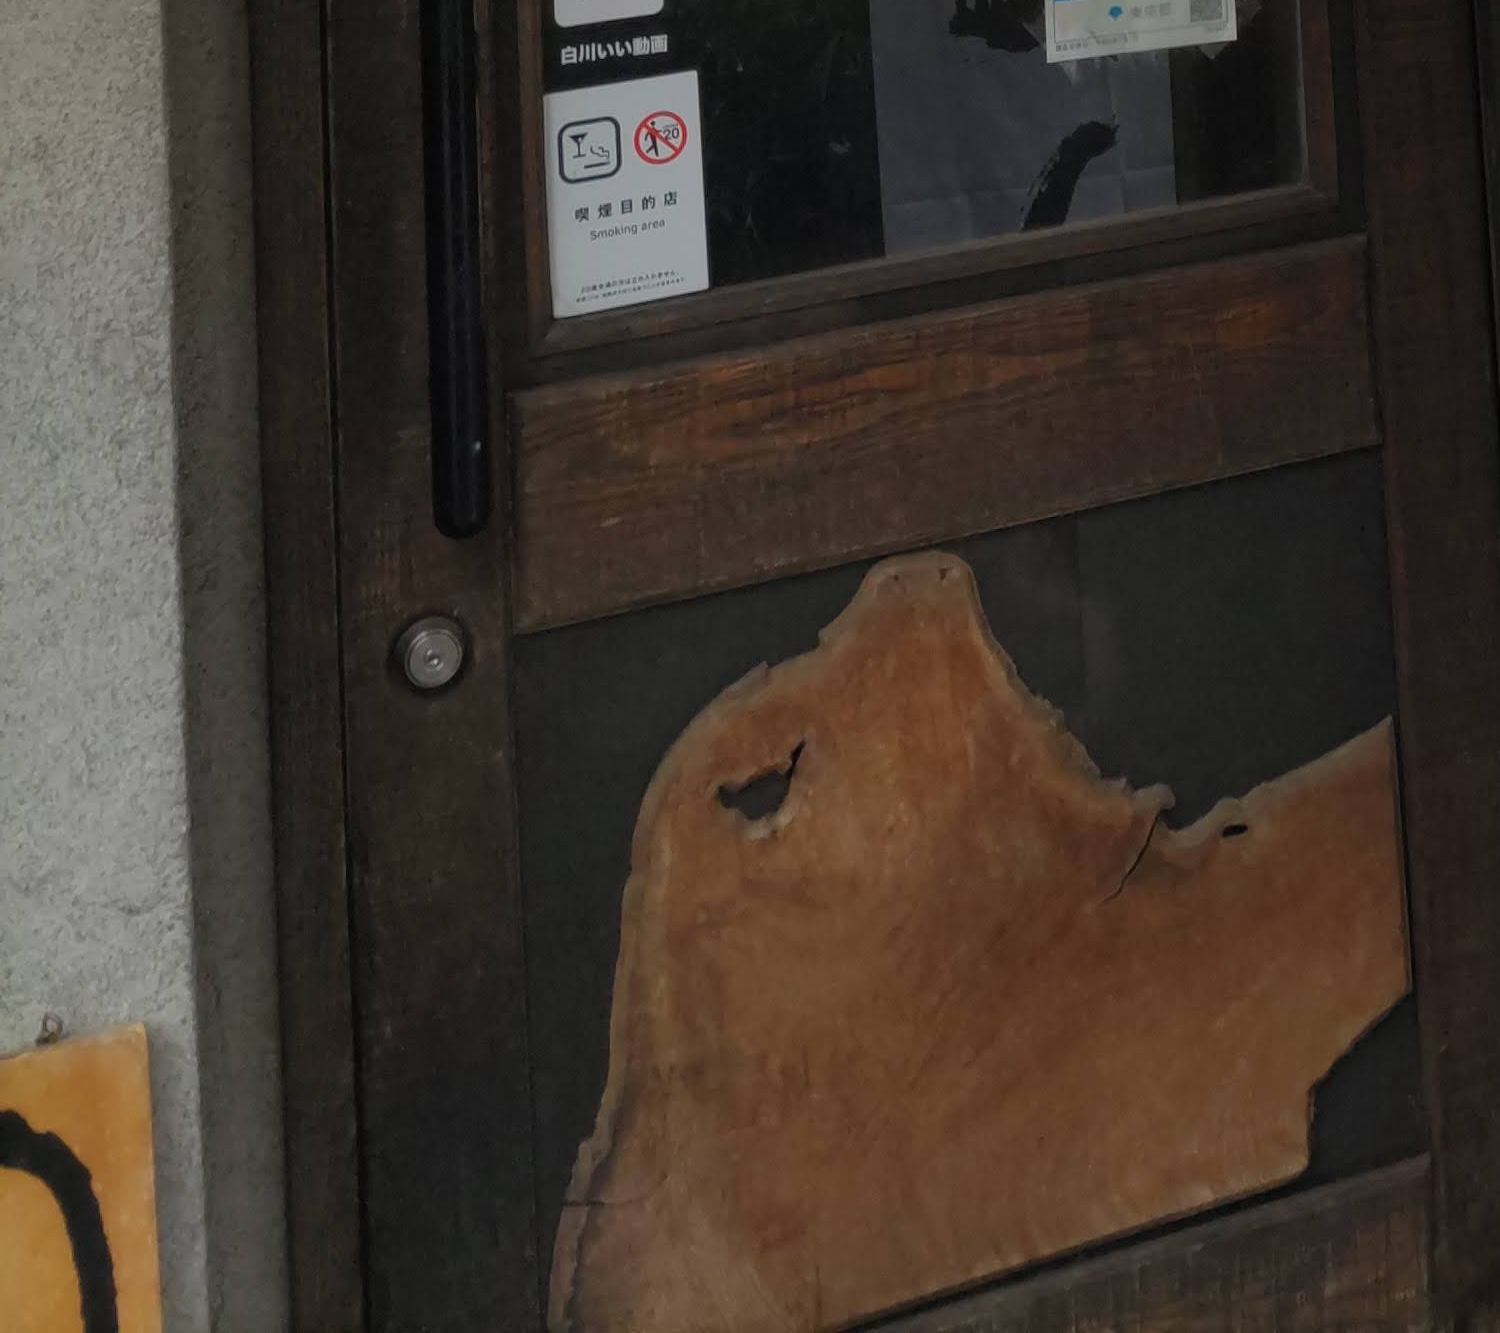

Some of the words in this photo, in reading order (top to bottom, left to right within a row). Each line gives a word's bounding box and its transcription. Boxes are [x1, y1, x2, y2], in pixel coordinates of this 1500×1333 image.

[574, 190, 678, 223] 喫煙目的店
[590, 221, 638, 241] Smoking
[641, 218, 666, 232] area
